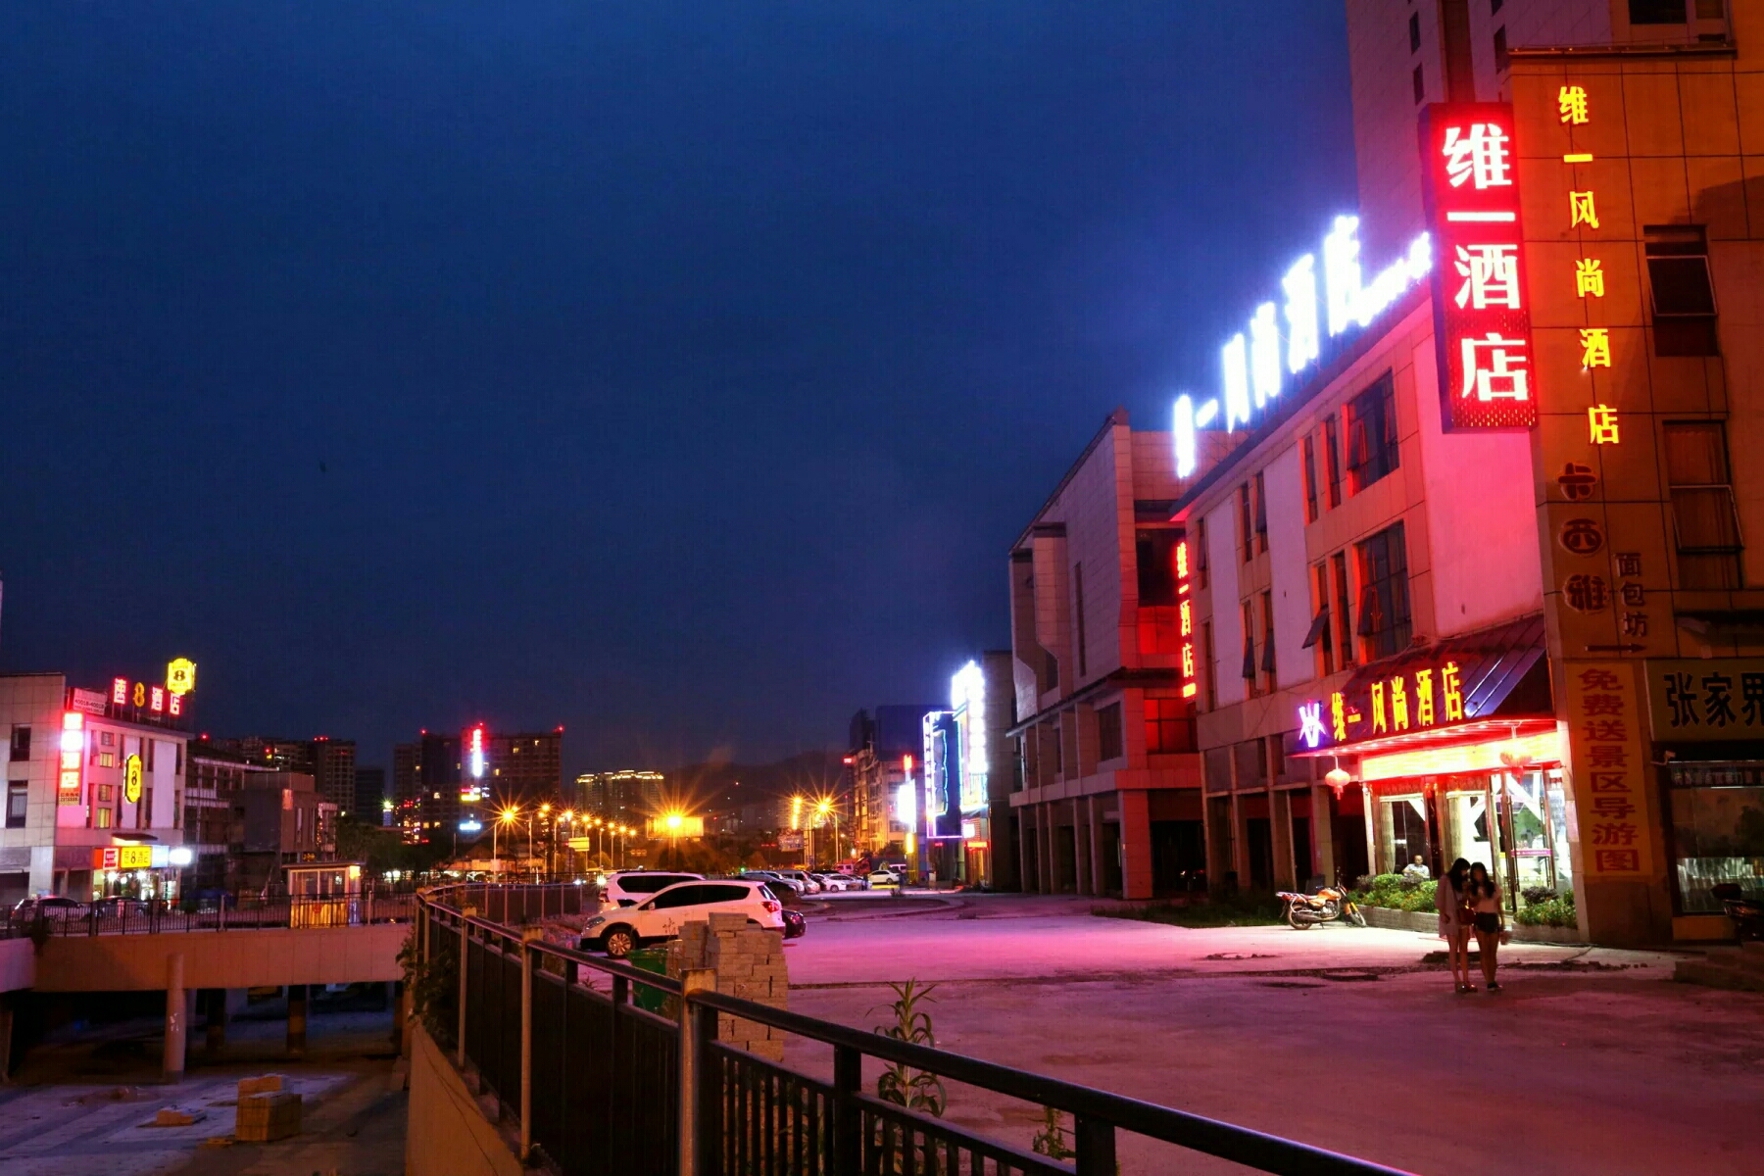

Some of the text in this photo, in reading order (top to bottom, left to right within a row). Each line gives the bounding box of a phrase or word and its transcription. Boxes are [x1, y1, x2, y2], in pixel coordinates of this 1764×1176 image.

[1442, 122, 1529, 402] 维一酒店
[1558, 86, 1620, 444] 维一风尚酒店
[1614, 552, 1648, 637] 面包坊
[1332, 662, 1462, 741] 维一风尚酒店
[1578, 668, 1640, 872] 免费送景区导游图
[1664, 672, 1764, 728] 张家界
